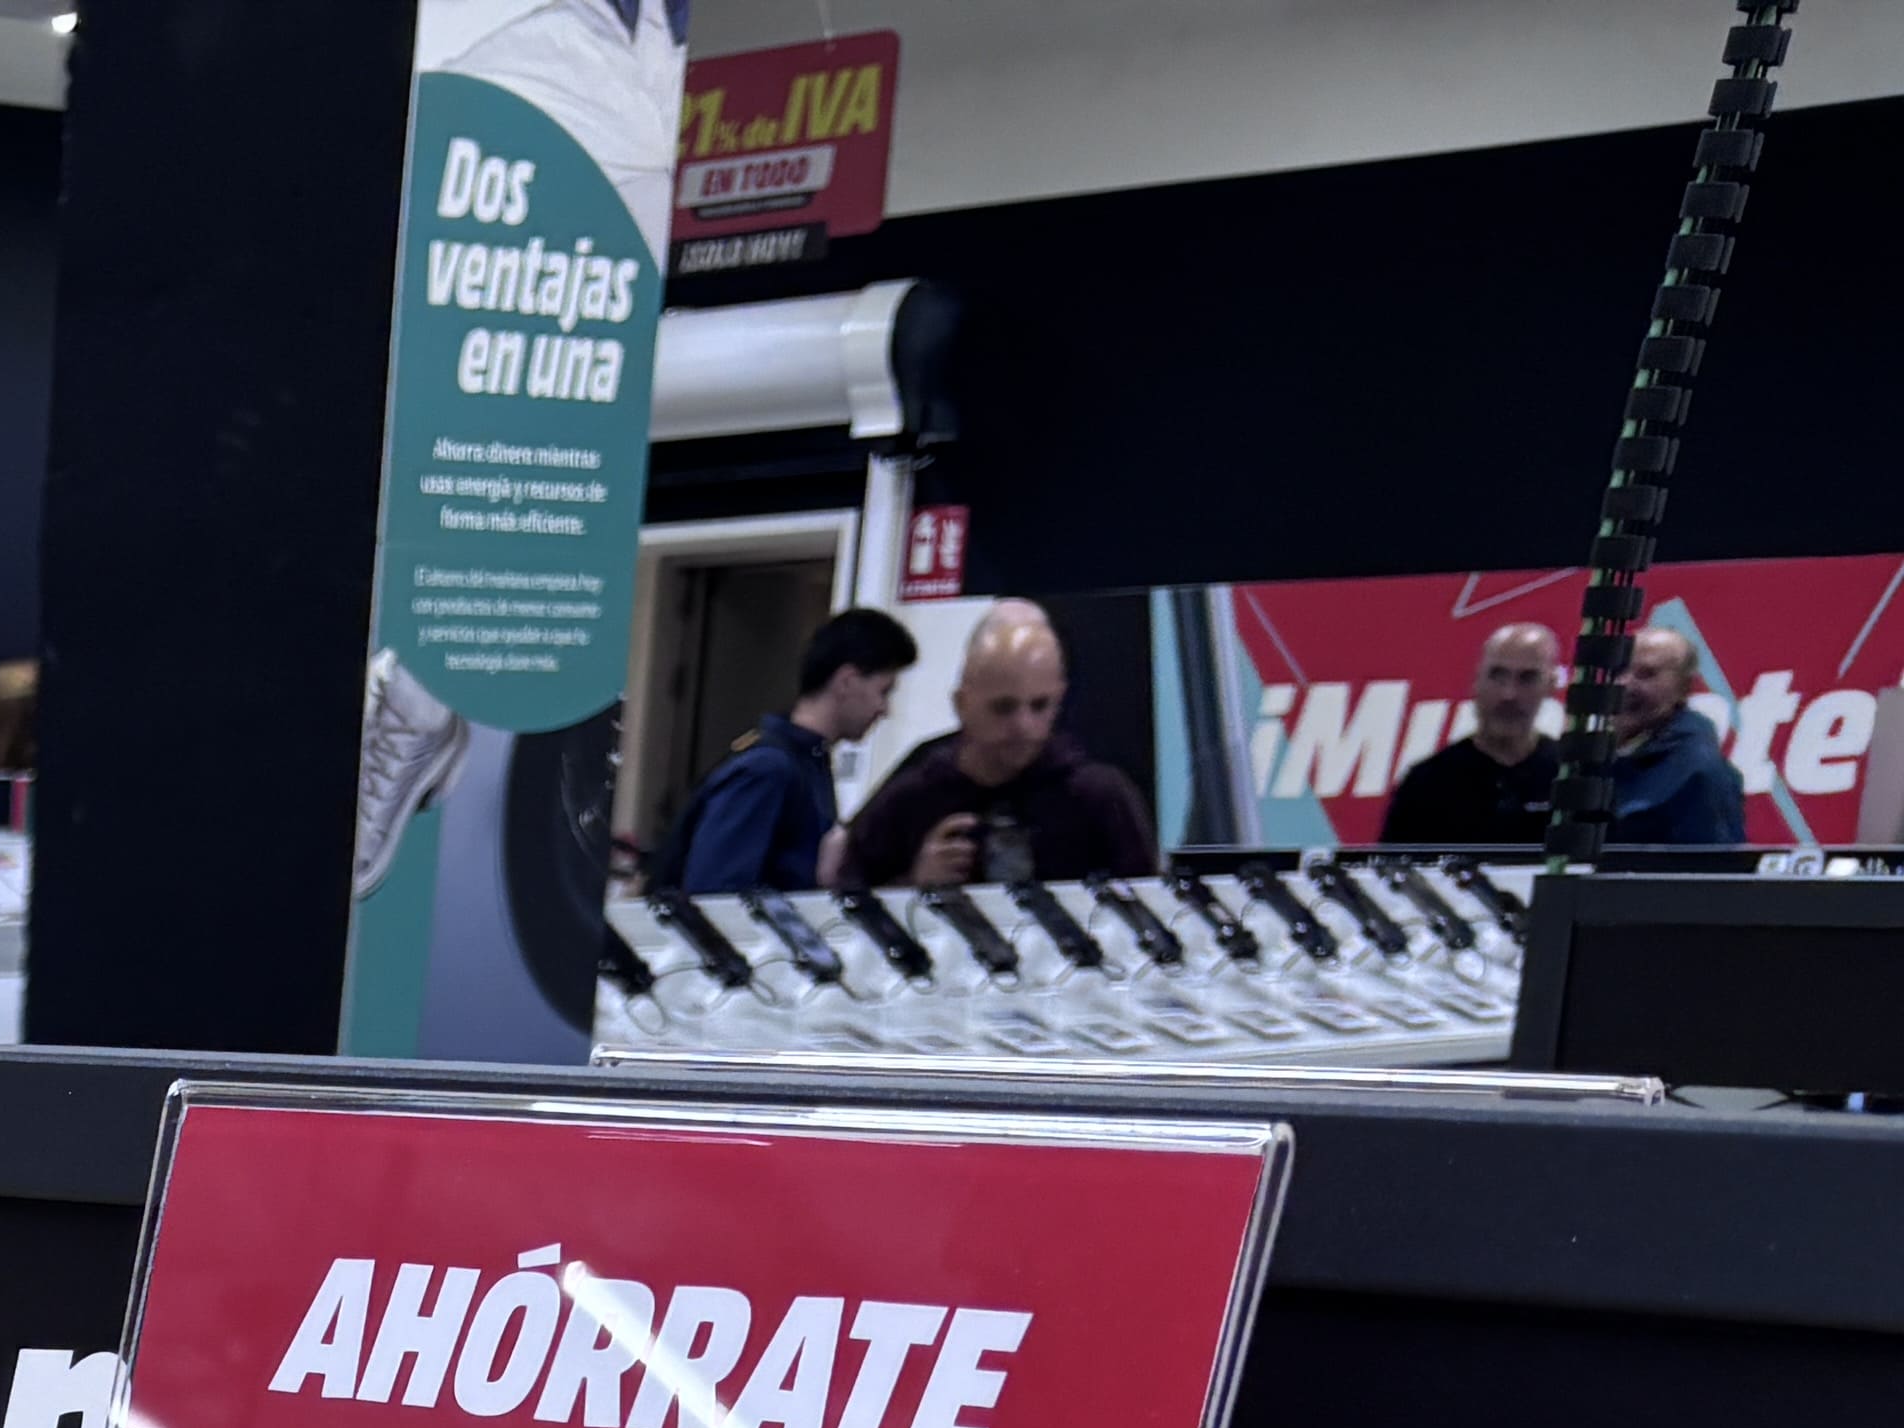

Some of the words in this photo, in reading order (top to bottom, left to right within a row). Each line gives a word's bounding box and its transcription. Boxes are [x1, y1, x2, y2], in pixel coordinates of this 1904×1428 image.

[782, 64, 882, 144] IVA
[437, 136, 536, 226] Dos
[427, 236, 640, 333] ventajas
[457, 327, 526, 395] en
[526, 332, 625, 402] una
[434, 437, 485, 462] Ahorra
[456, 474, 511, 503] energía
